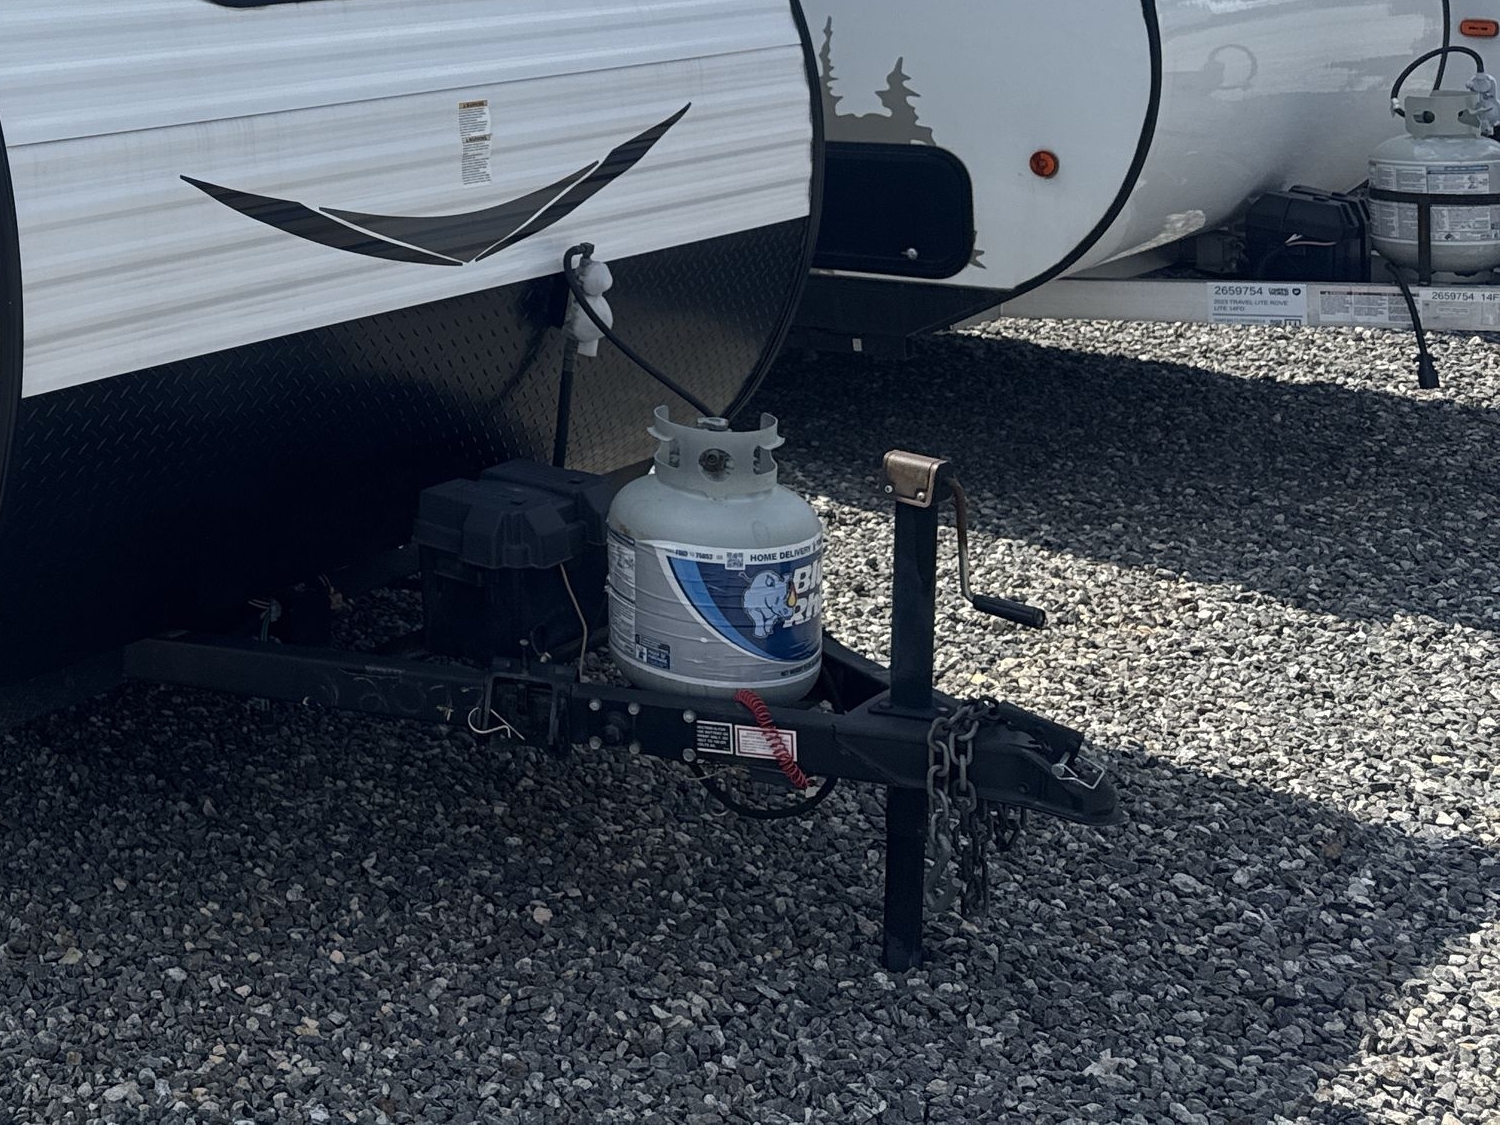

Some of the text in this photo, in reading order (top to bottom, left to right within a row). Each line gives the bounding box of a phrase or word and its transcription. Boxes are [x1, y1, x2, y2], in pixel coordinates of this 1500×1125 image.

[1213, 285, 1263, 296] 2659754
[1431, 291, 1474, 301] 2659754
[750, 545, 811, 563] HOME DELIVERY
